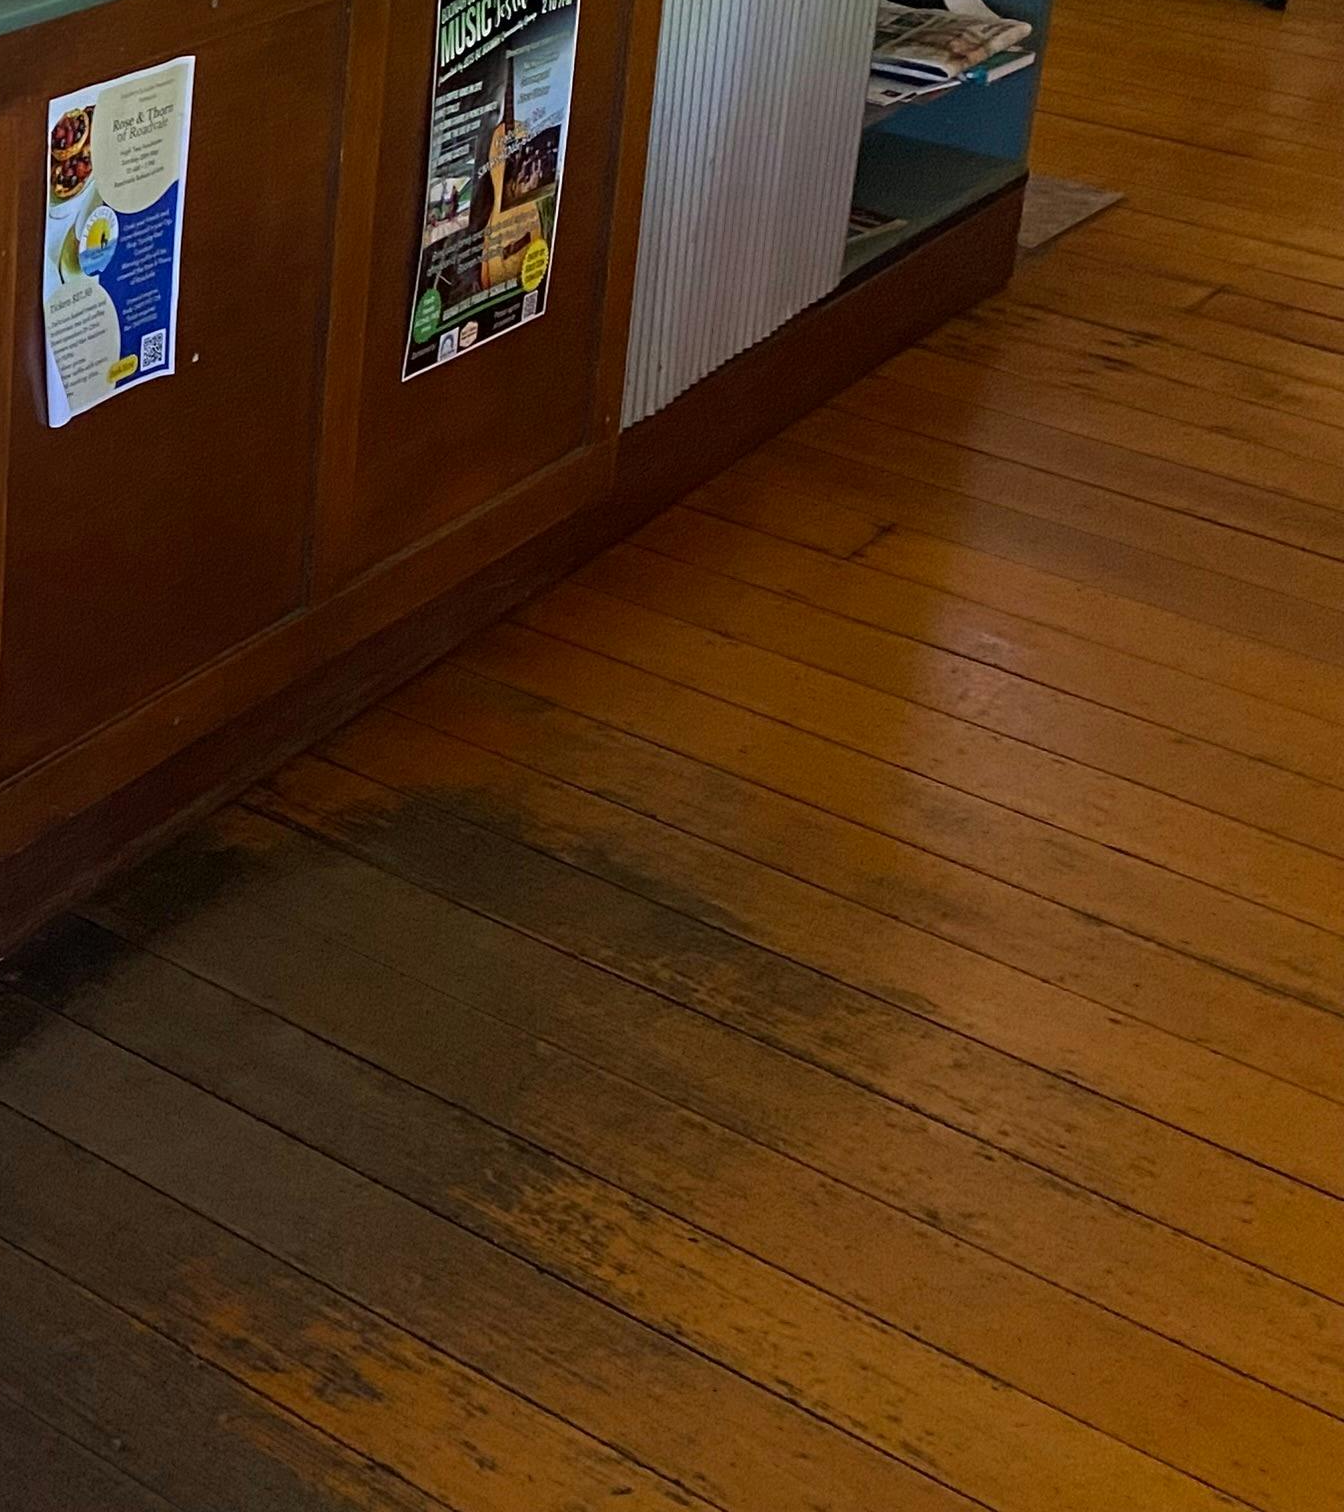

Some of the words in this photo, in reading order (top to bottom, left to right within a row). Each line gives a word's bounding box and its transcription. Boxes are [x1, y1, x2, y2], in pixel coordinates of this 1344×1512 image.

[541, 0, 548, 14] 2
[113, 116, 135, 133] Rose
[136, 111, 145, 124] &
